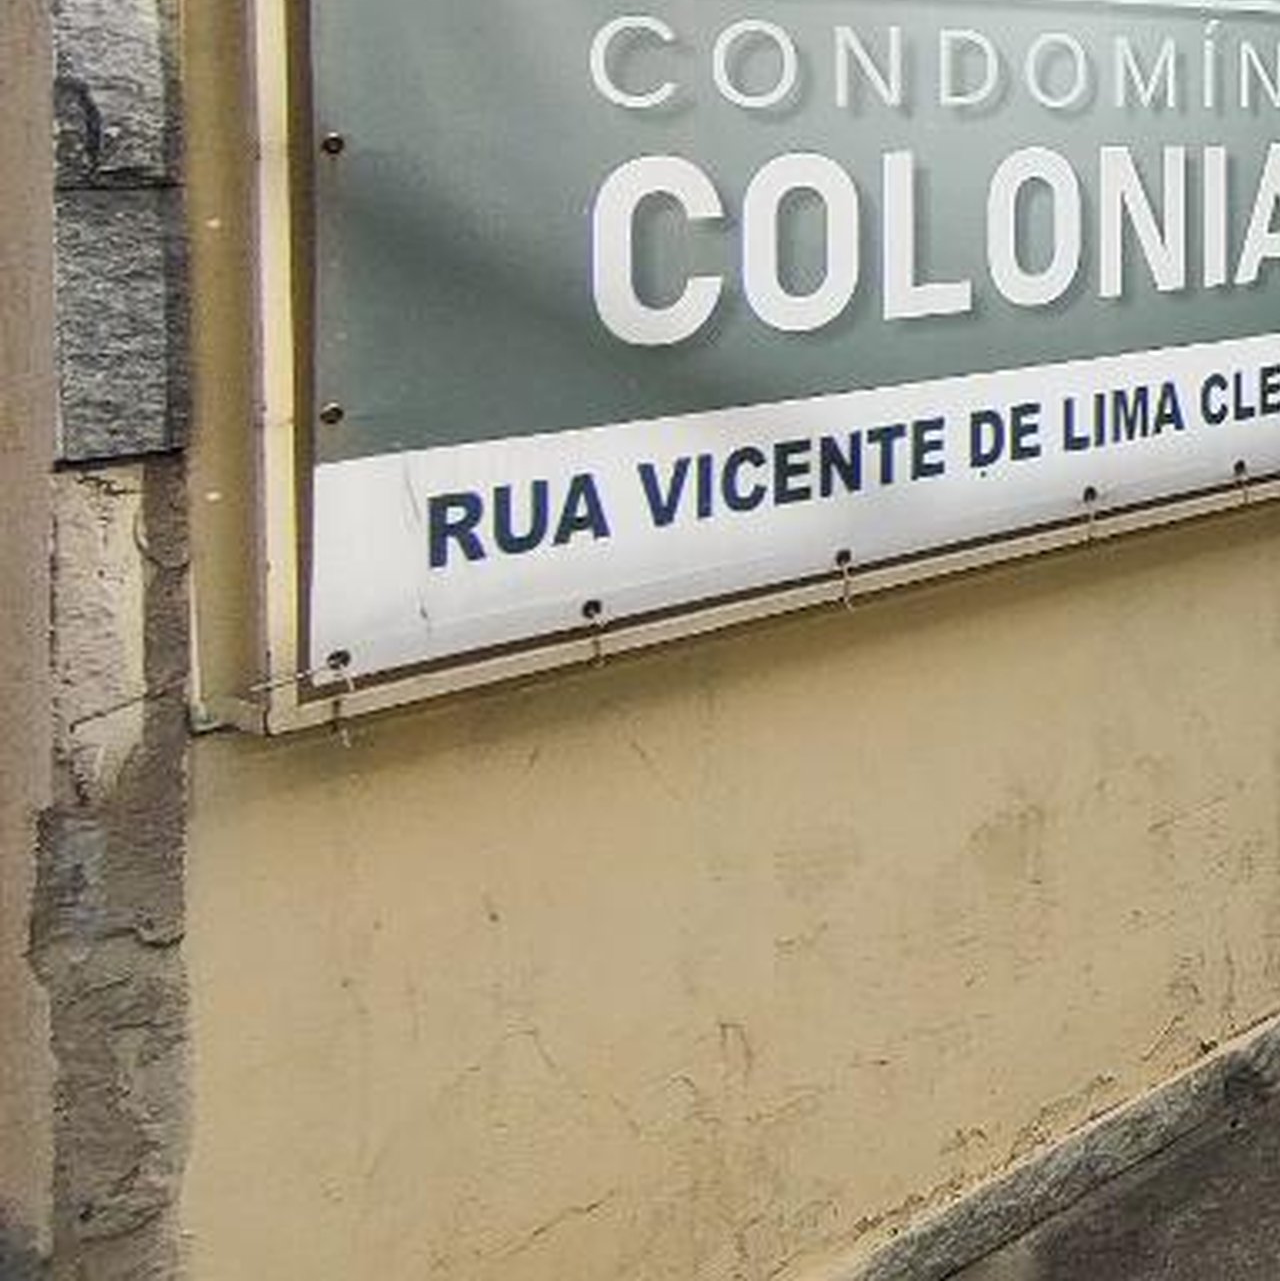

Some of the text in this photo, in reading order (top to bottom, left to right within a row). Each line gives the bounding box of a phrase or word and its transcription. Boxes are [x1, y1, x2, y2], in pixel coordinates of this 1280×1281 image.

[427, 473, 612, 569] RUA
[637, 417, 947, 527] VICENTE
[969, 401, 1042, 467] DE
[1062, 381, 1184, 452] LIMA
